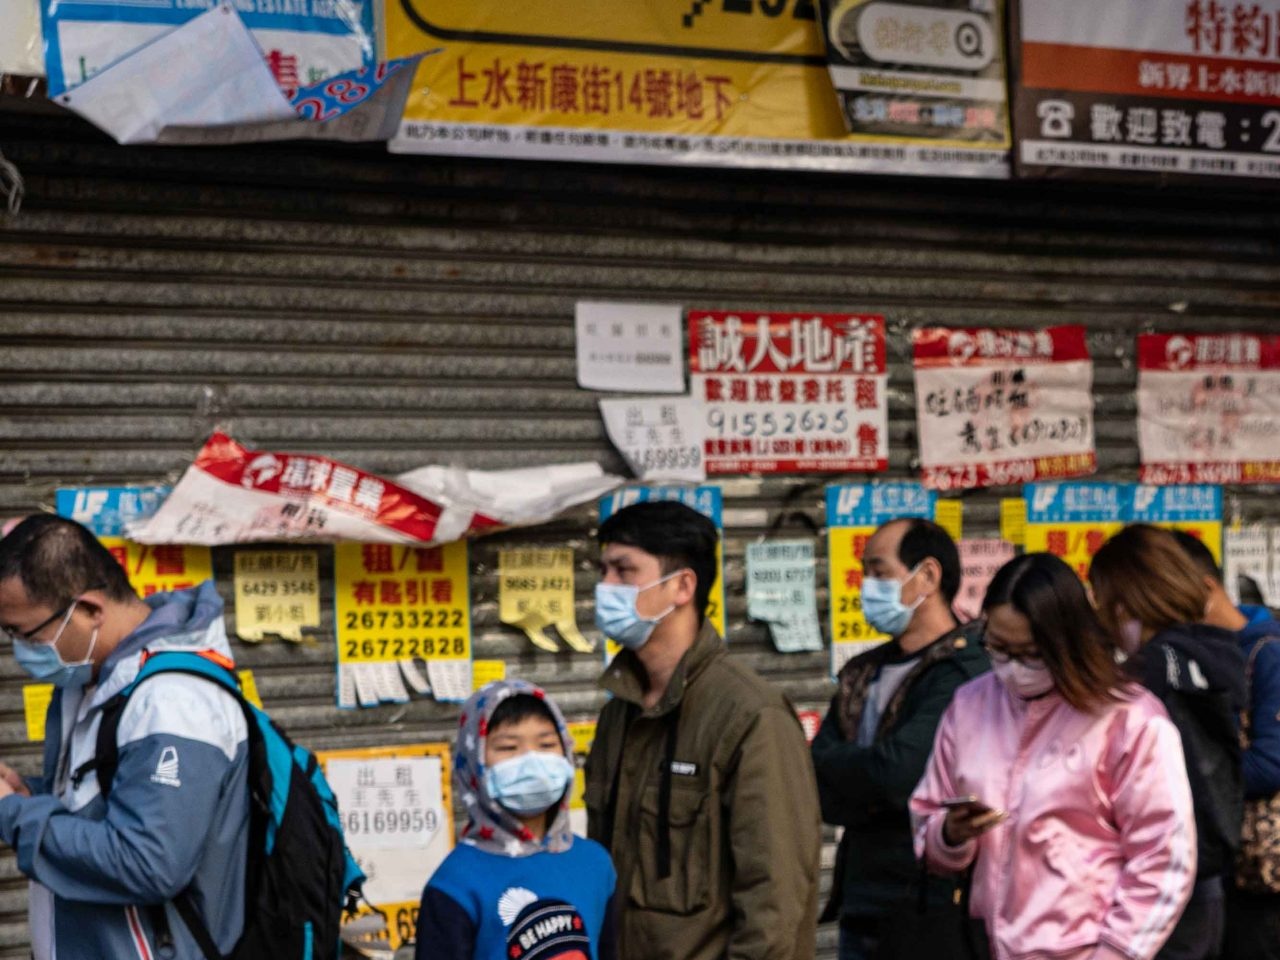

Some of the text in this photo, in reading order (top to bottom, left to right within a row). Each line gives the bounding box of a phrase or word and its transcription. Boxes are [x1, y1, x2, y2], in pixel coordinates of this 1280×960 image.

[449, 56, 732, 121] 上水新康街14號地下
[698, 315, 878, 373] 誠大地產
[346, 610, 464, 631] 26733222
[346, 638, 466, 659] 26722828
[519, 915, 574, 950] BE HAPPY
